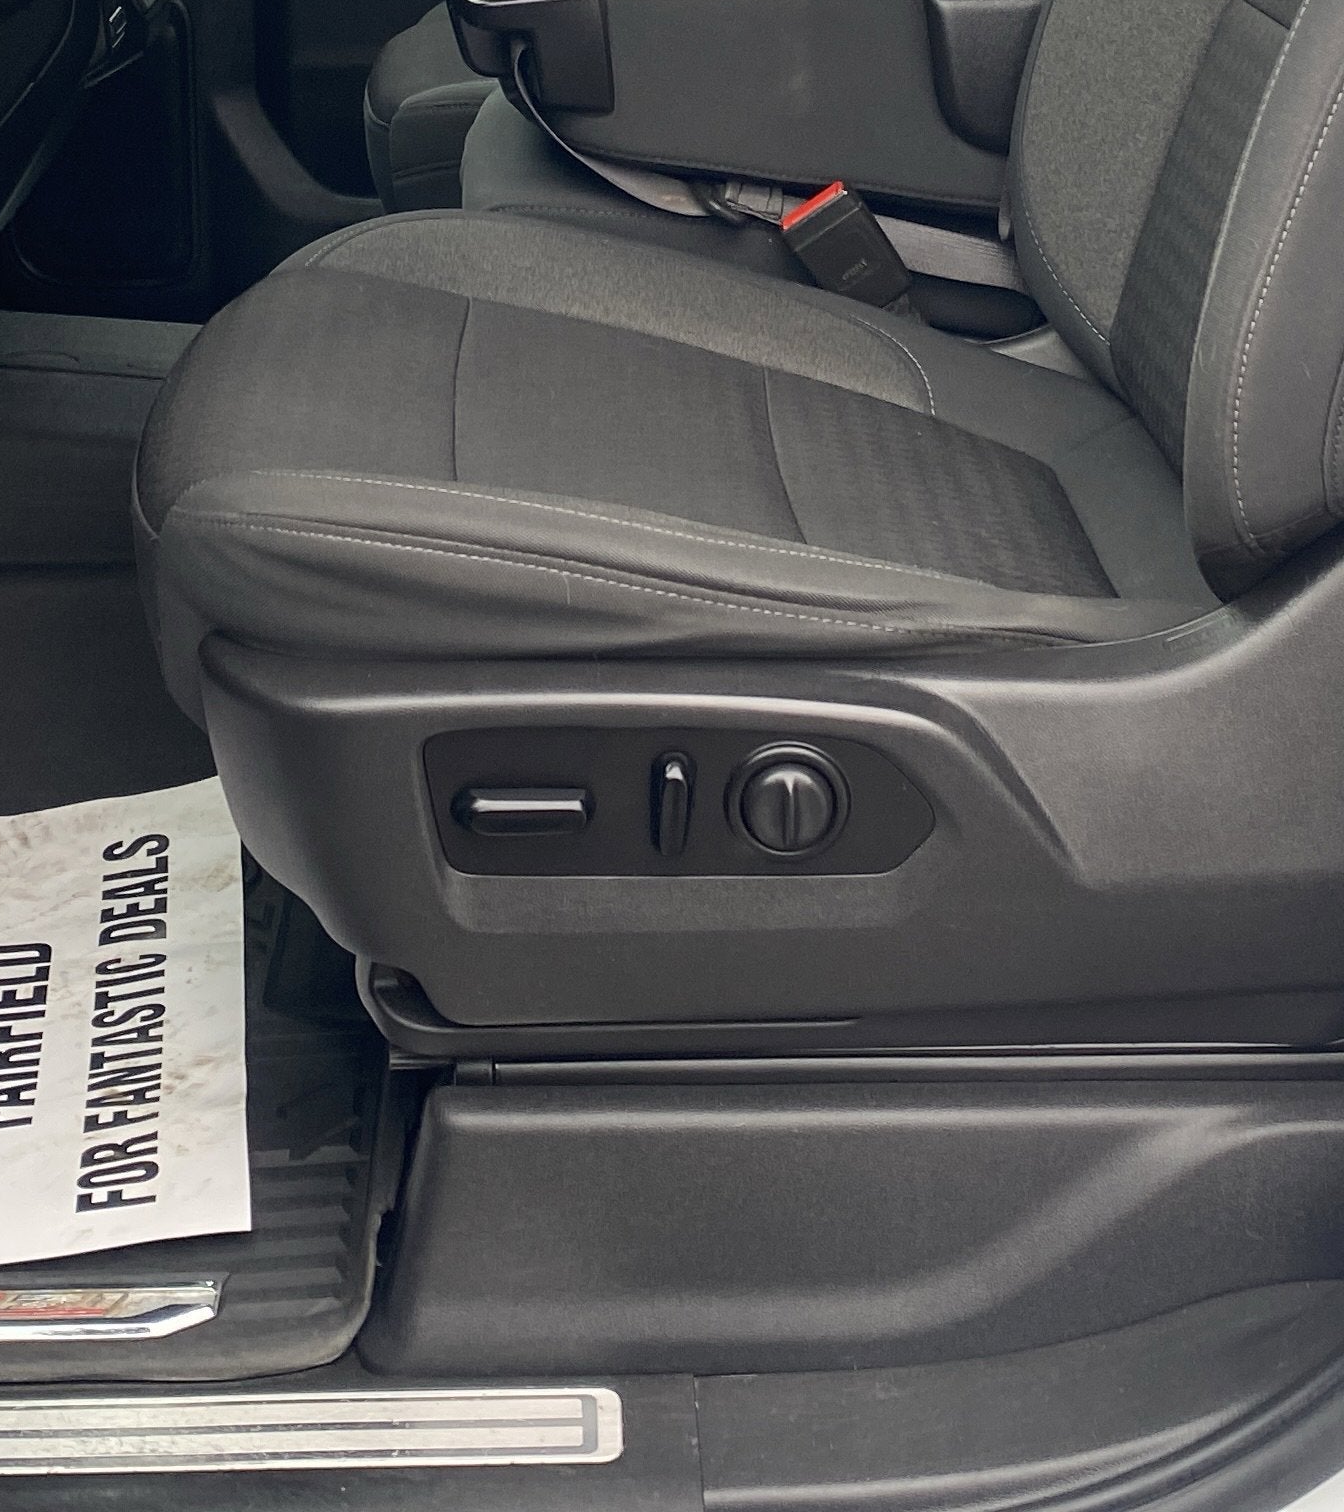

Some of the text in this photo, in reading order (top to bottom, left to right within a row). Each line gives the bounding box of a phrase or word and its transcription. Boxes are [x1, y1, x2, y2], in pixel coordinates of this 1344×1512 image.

[75, 832, 170, 1214] FOR FANTASTIC DEALS
